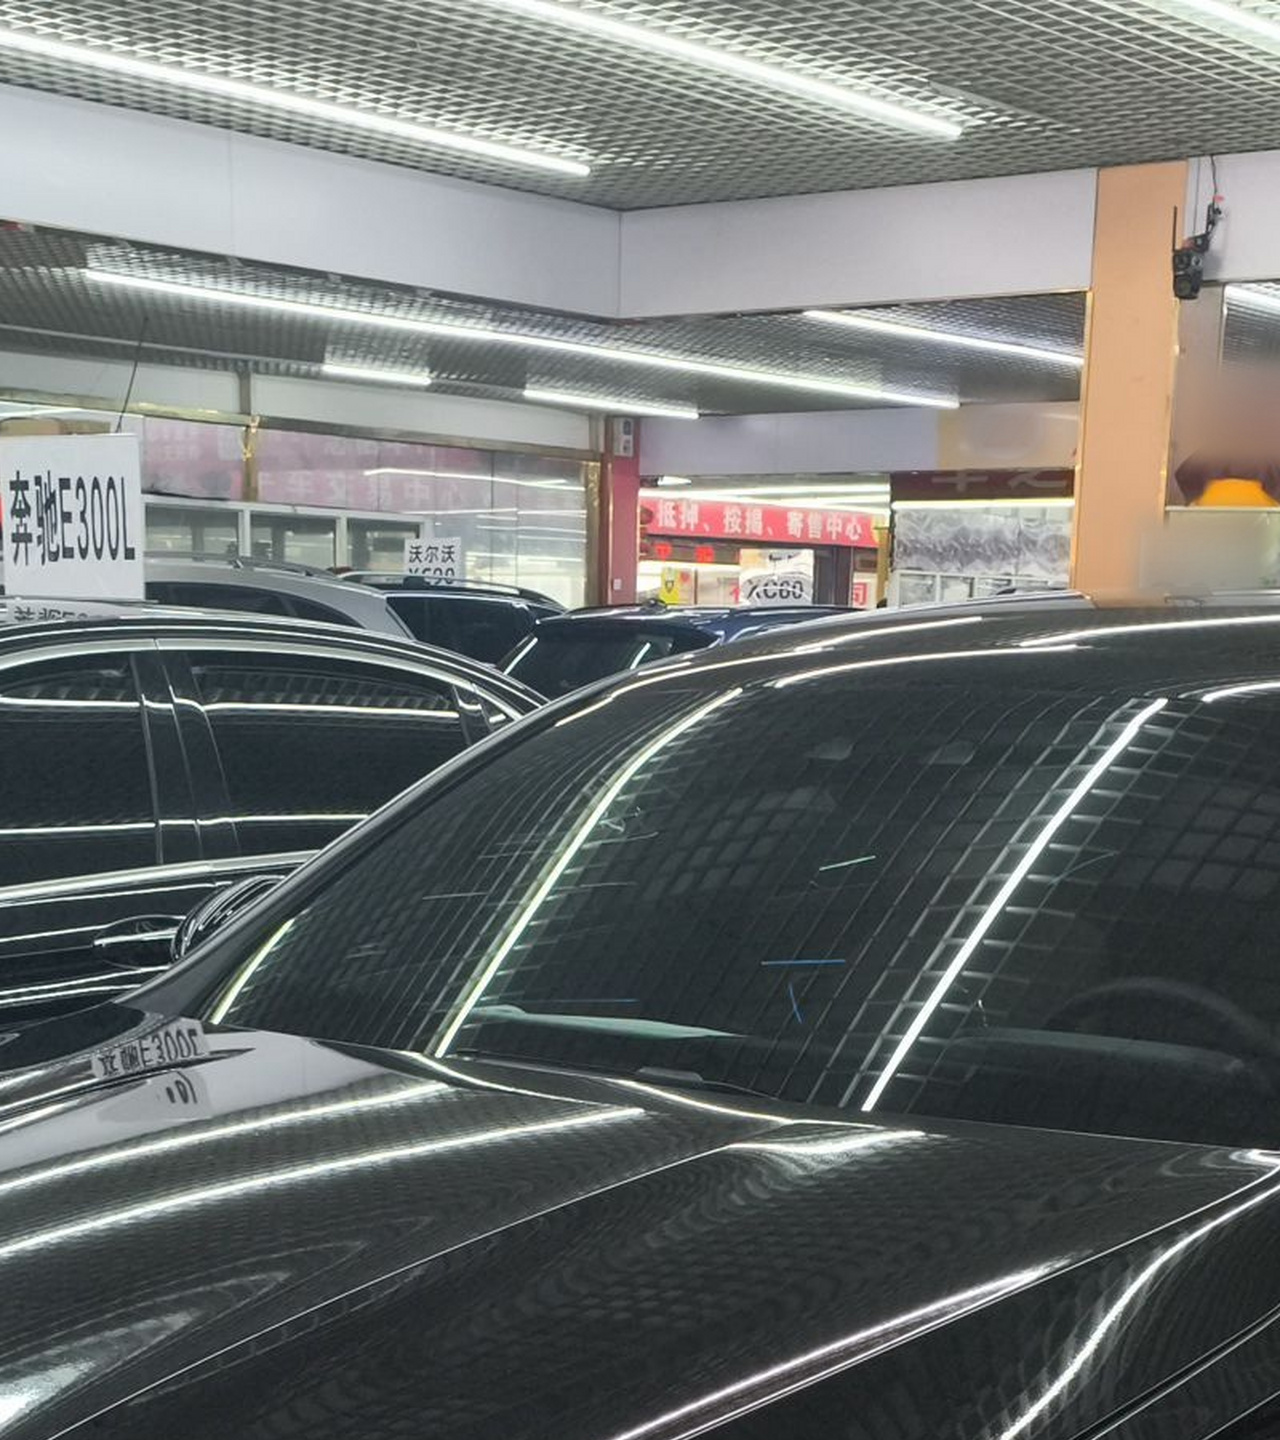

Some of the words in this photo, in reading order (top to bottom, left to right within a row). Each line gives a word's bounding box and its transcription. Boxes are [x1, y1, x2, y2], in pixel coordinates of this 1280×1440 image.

[9, 470, 135, 566] 奔驰E300L
[657, 500, 862, 540] 抵押、按揭、寄售中心
[409, 545, 455, 563] 沃尔沃
